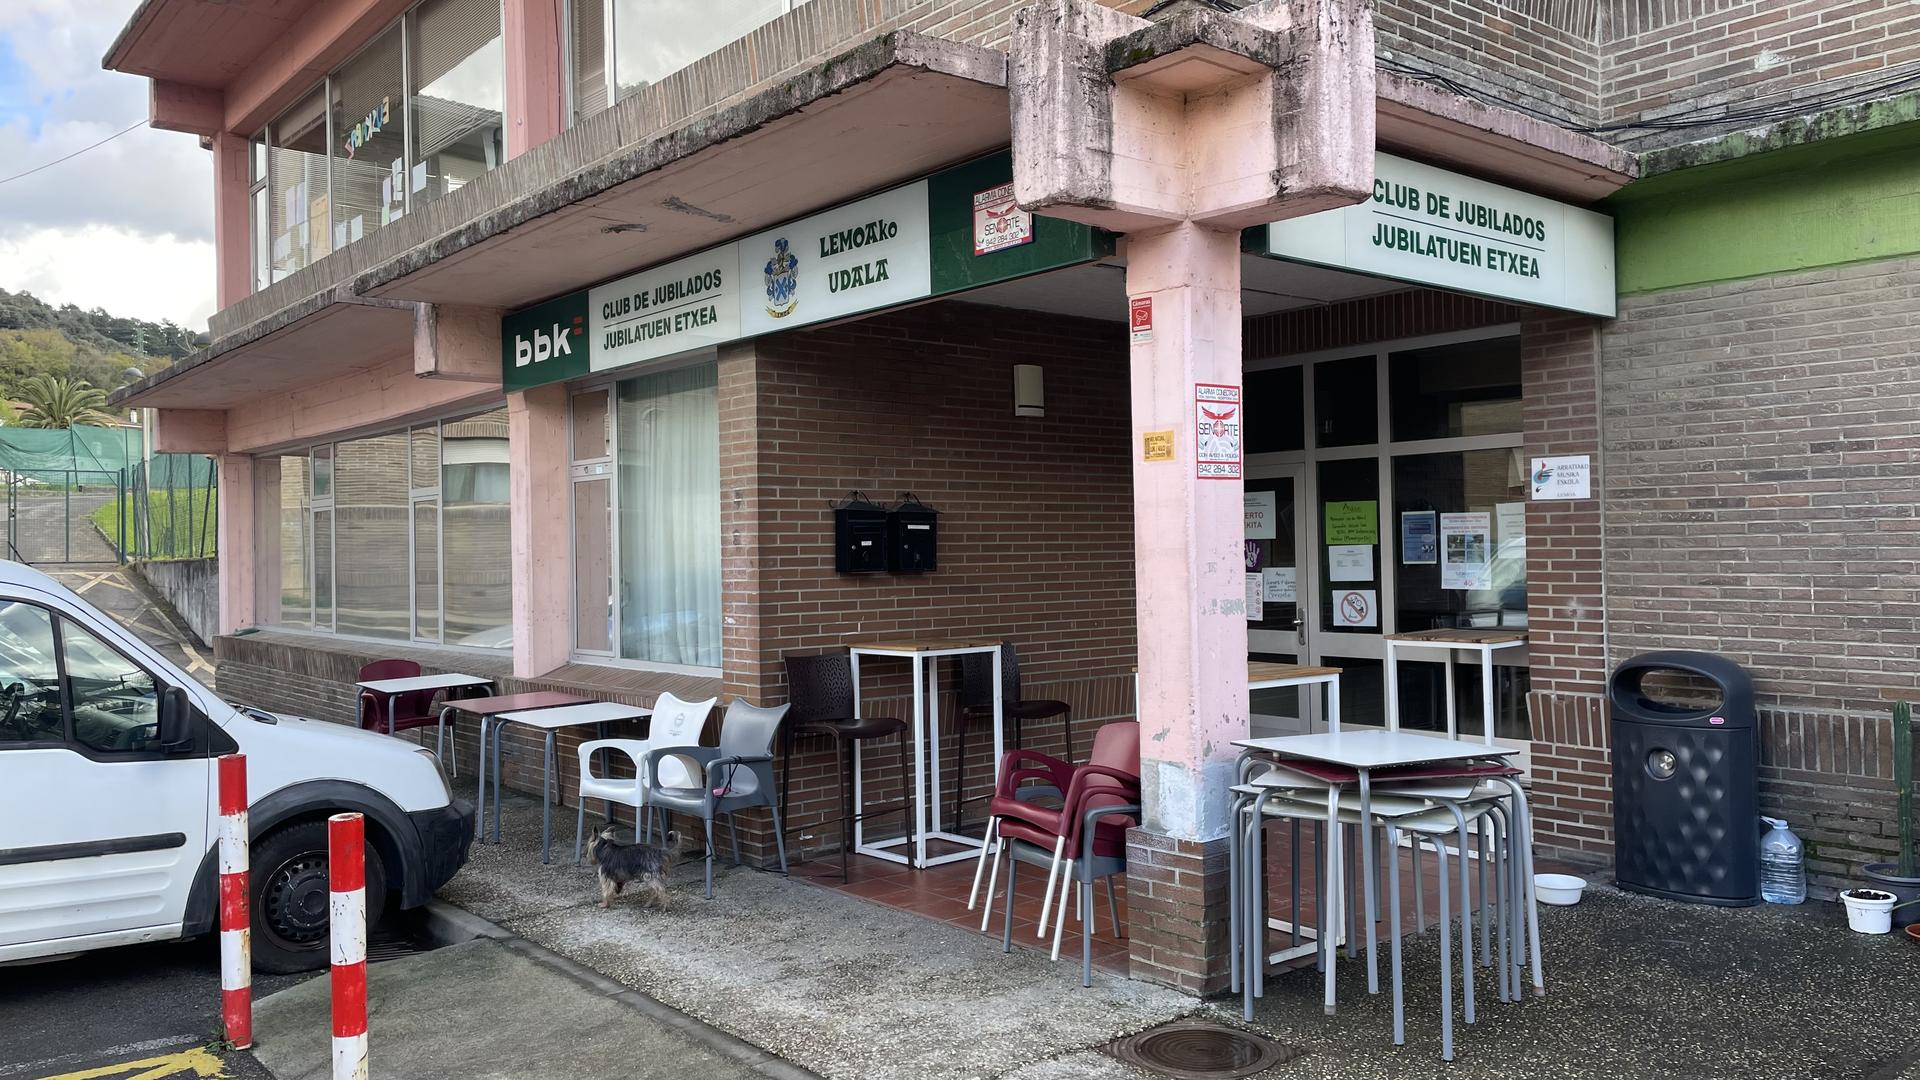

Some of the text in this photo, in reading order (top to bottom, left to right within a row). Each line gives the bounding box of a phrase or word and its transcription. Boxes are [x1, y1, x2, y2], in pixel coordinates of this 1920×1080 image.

[1373, 178, 1545, 242] CLUB DE JUBILADOS
[1372, 223, 1540, 279] JUBILATUEN ETXEA
[602, 268, 722, 320] CLUB DE JUBILADOS
[828, 258, 890, 294] UDALA
[515, 322, 572, 368] bbk
[603, 304, 718, 350] JUBILATUEN ETXEA
[1198, 464, 1239, 474] 942 284 302
[1244, 511, 1264, 520] ERTO
[1244, 521, 1263, 529] KITA
